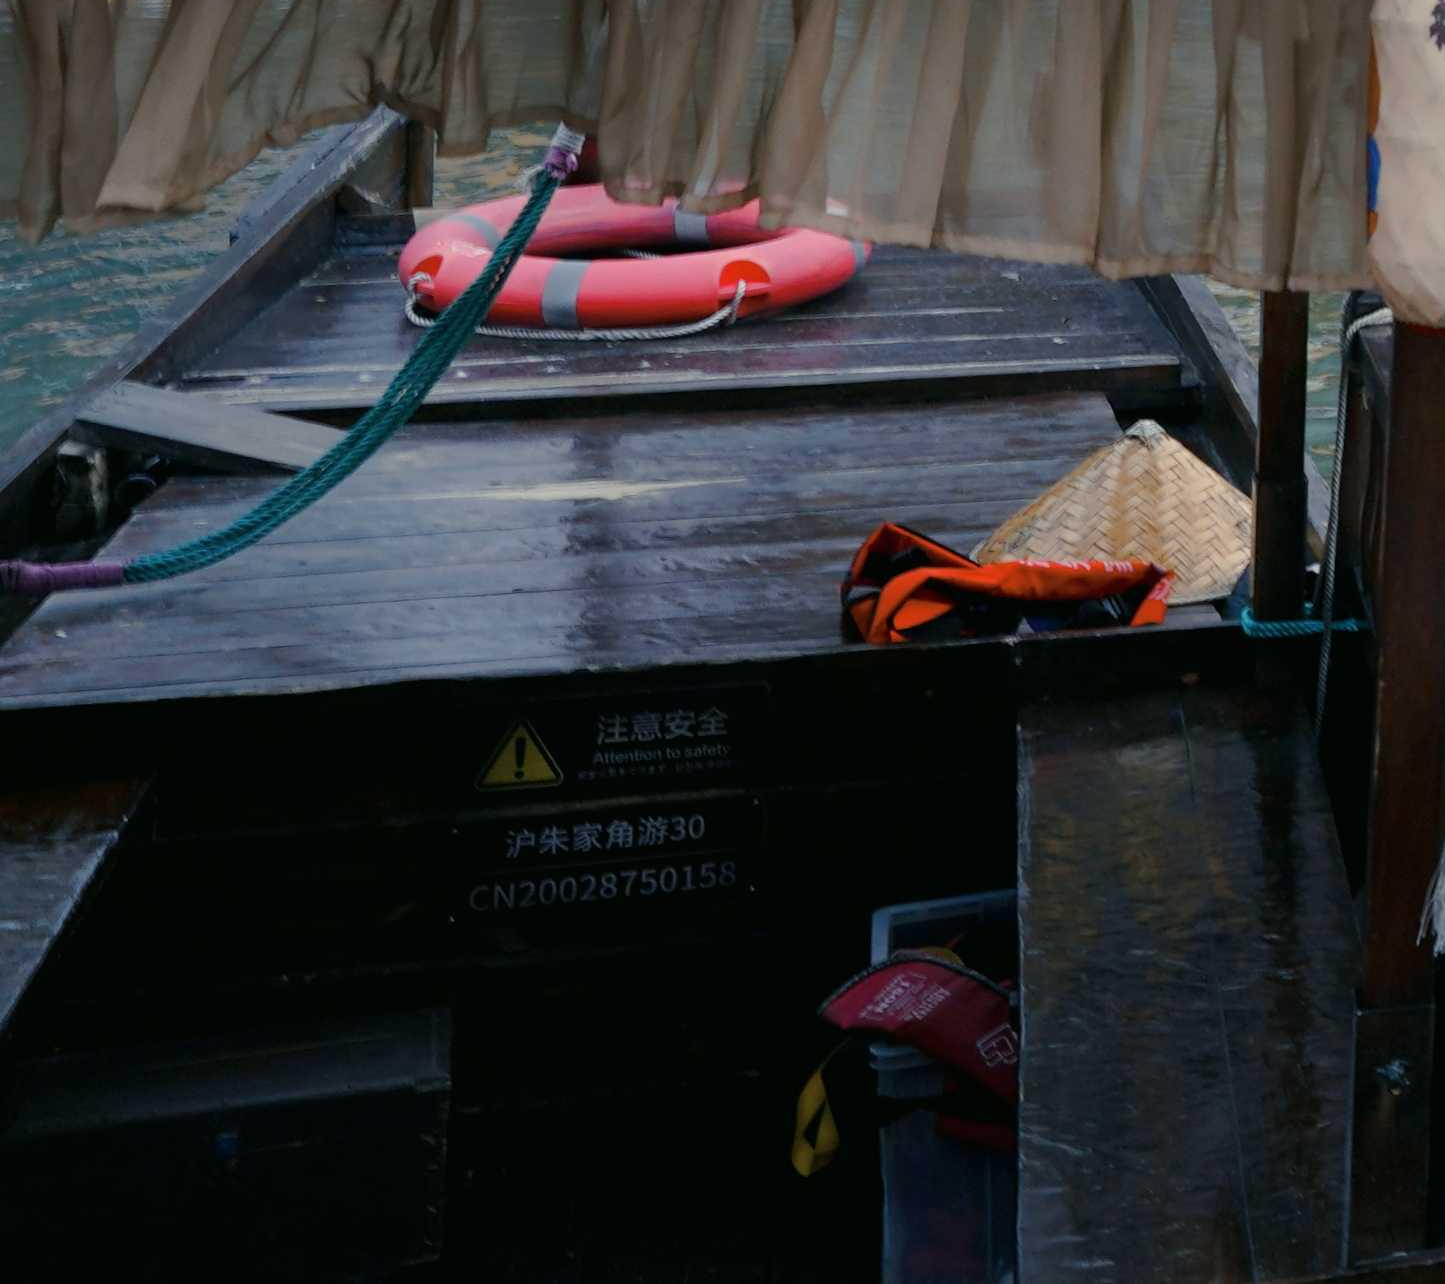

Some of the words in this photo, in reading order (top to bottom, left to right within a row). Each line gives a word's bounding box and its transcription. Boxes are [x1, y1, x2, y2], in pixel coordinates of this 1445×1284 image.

[596, 706, 729, 744] 注意安全
[592, 749, 662, 765] Attention
[666, 746, 681, 759] to
[684, 743, 731, 759] safety
[503, 814, 706, 859] 沪朱家角游30
[468, 861, 737, 912] CN20028750158
